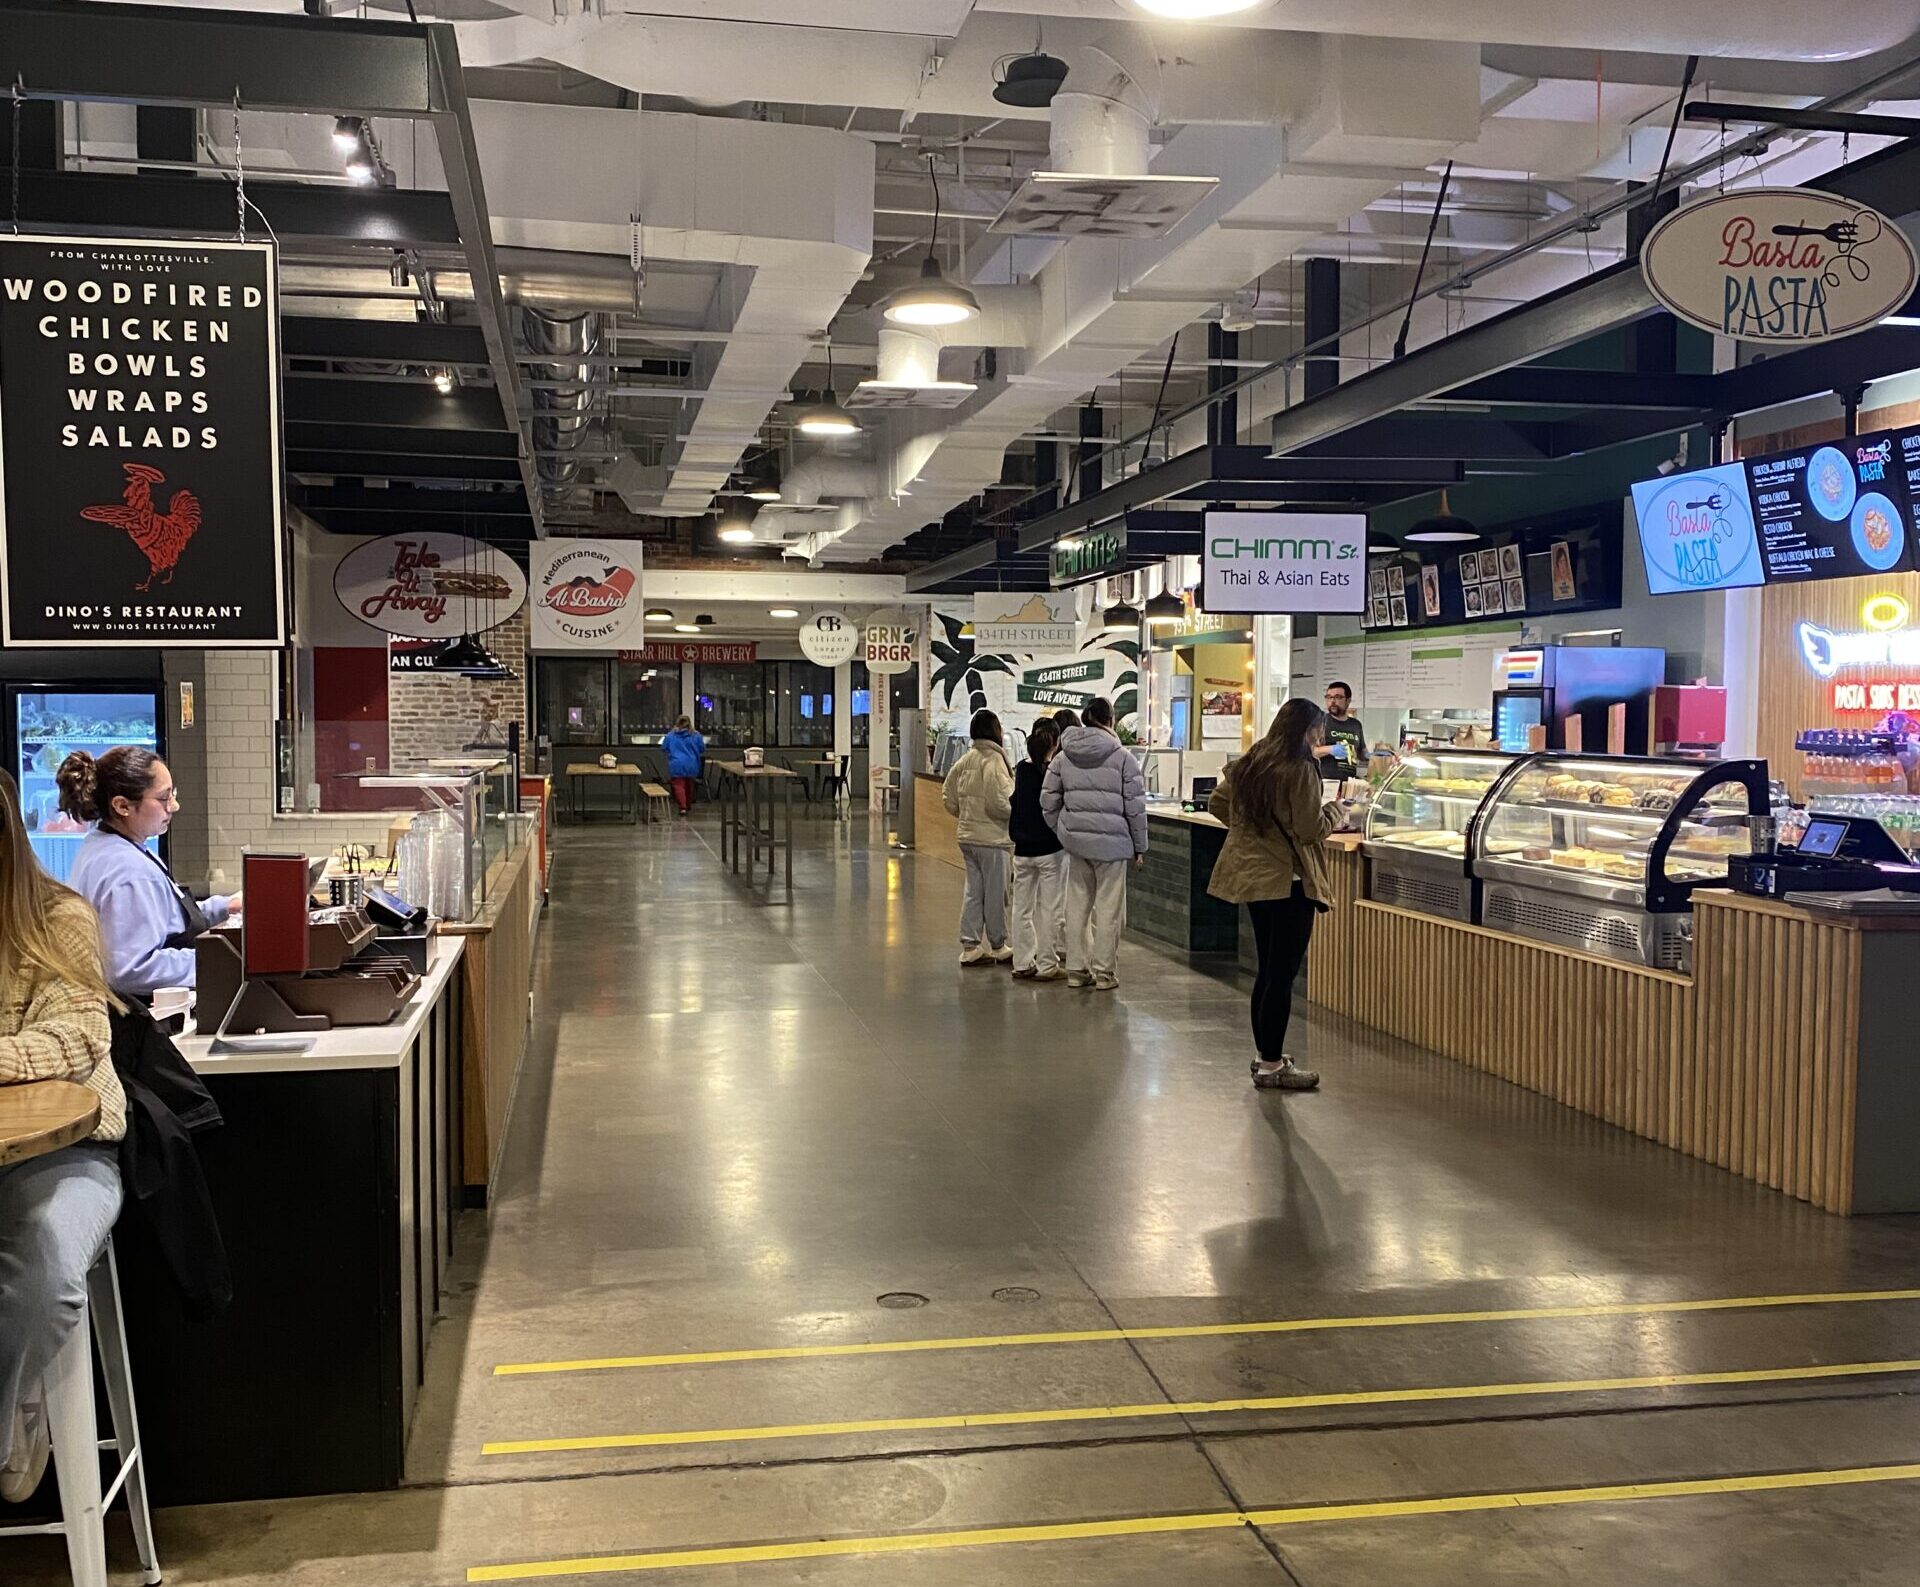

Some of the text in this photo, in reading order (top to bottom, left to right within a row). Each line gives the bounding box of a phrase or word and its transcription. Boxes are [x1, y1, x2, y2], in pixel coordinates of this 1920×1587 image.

[1718, 216, 1826, 269] Basta
[50, 251, 85, 259] FROM
[100, 263, 171, 273] WITH LOVE
[3, 278, 262, 308] WOODFIRED
[1723, 275, 1829, 335] PASTA
[39, 316, 229, 343] CHICKEN
[68, 353, 206, 378] BOWLS
[68, 389, 209, 413] WRAPS
[62, 425, 218, 449] SALADS
[1667, 496, 1711, 537] Basta
[394, 541, 440, 569] Take
[1336, 544, 1359, 560] St.
[1674, 538, 1722, 584] PASTA
[542, 550, 611, 587] Mediterranean
[1220, 569, 1350, 586] Thai & Asian Eats
[360, 585, 447, 624] Away
[537, 587, 627, 609] Al Basha
[45, 606, 243, 618] DINO'S RESTAURANT
[561, 622, 615, 639] CUISINE
[867, 627, 900, 643] GRN
[977, 629, 1075, 640] 434TH STREET
[622, 645, 752, 662] STARR HILL BREWERY
[867, 645, 911, 661] BRGR
[1037, 665, 1089, 684] 434TH STREET
[1033, 690, 1084, 706] LOVE AVENUE
